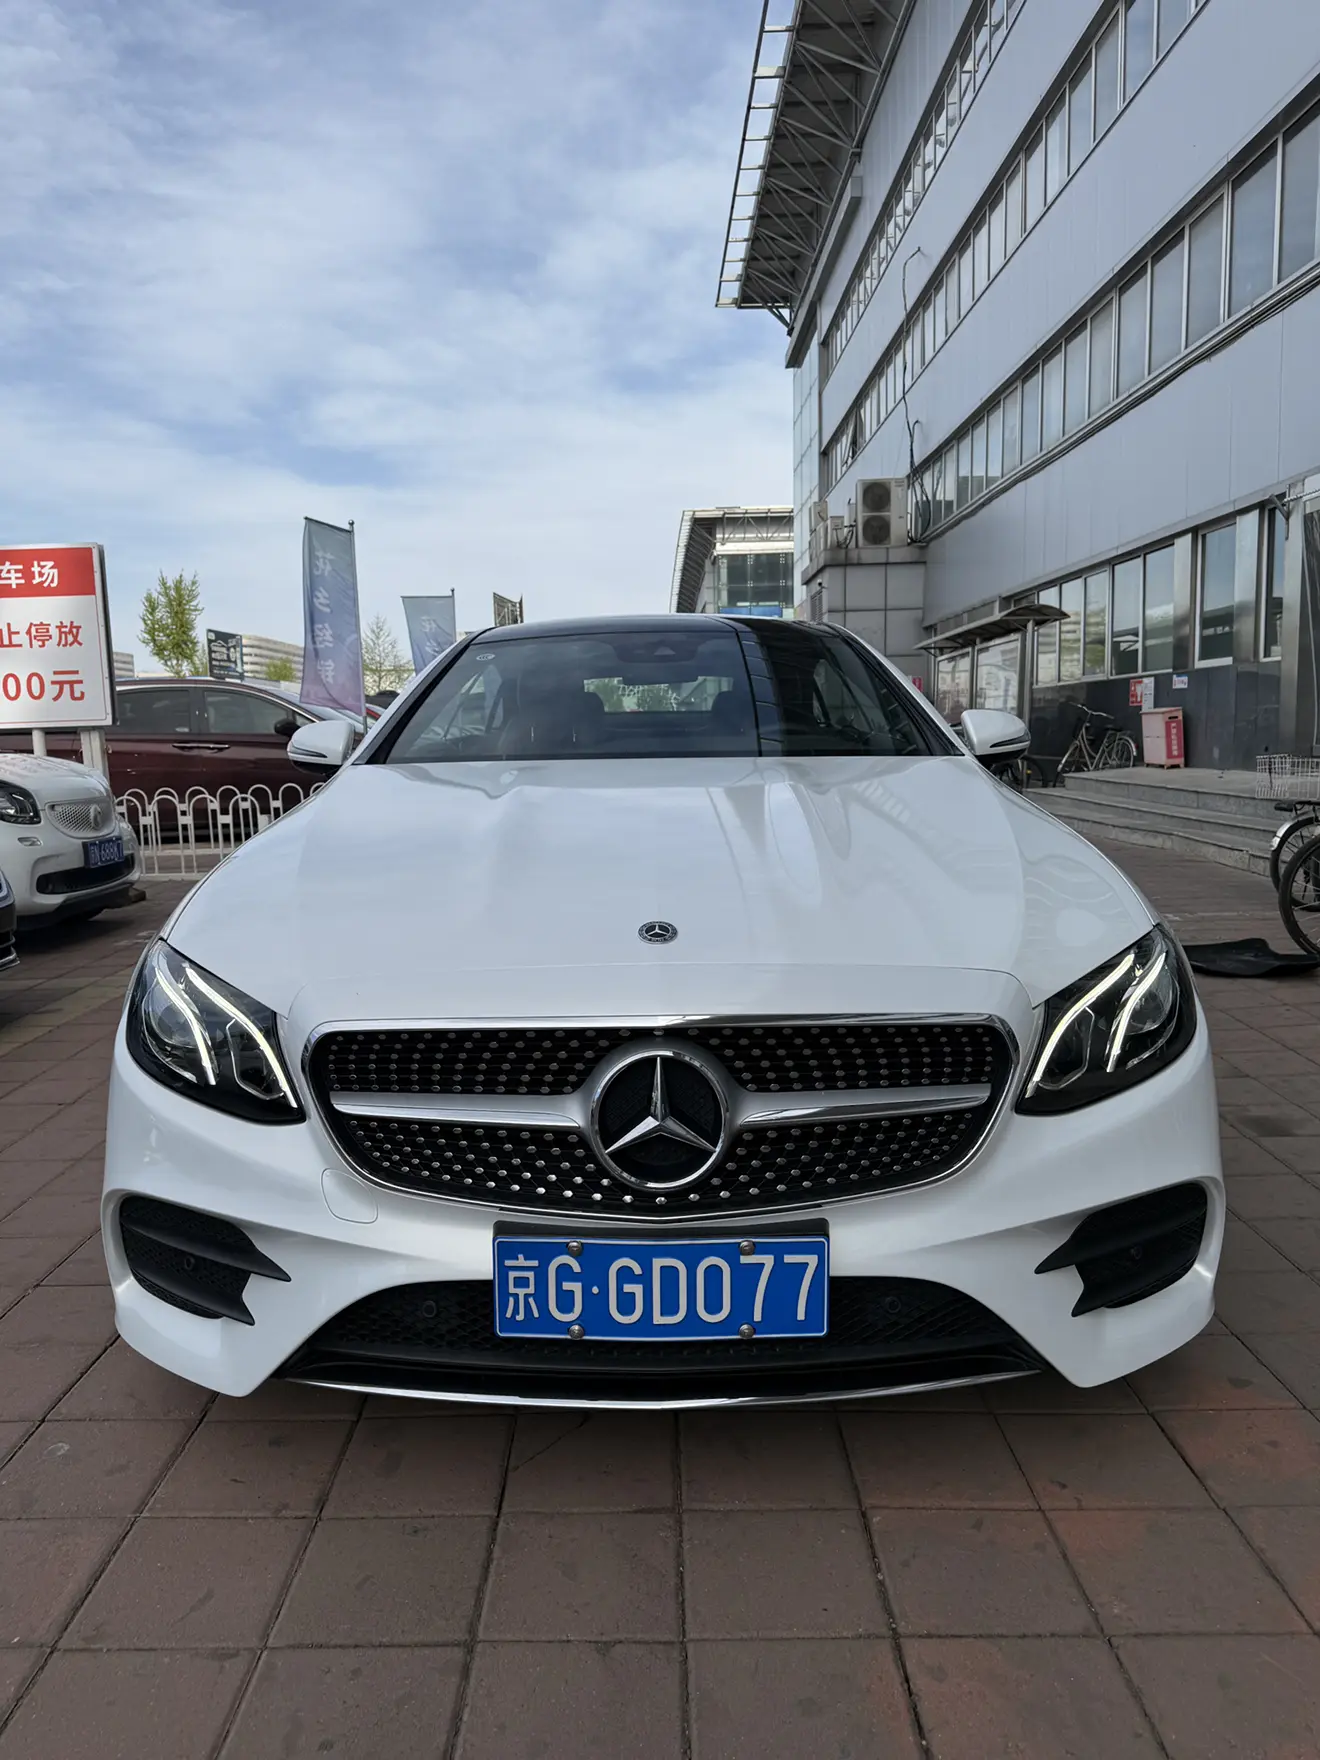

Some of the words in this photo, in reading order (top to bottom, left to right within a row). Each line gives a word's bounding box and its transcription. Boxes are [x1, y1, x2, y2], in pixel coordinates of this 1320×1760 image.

[0, 561, 59, 589] 车场
[0, 621, 83, 649] 止停放
[2, 670, 85, 702] 00元
[504, 1254, 819, 1324] 京G·GD077
